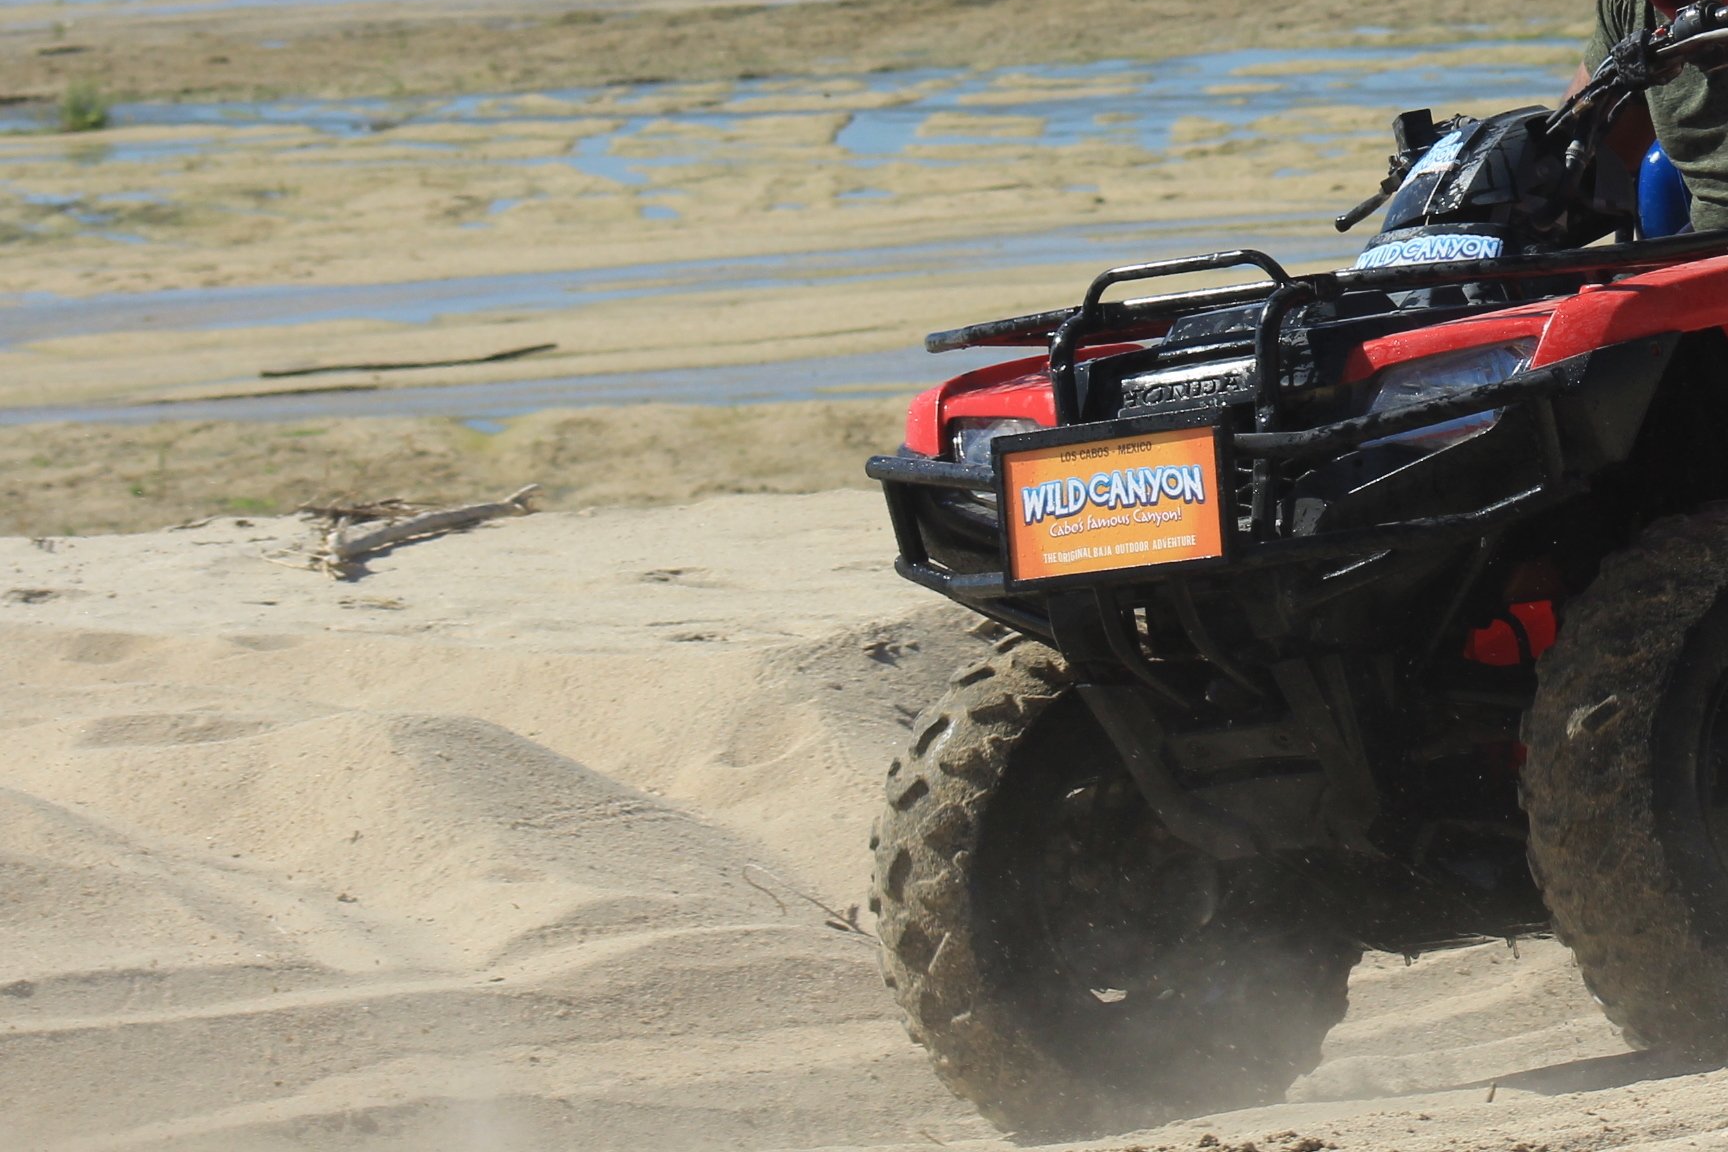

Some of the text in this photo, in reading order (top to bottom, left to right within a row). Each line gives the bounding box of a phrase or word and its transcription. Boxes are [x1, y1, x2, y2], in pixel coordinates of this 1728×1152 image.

[1355, 235, 1503, 269] WILD CANYON
[1124, 374, 1250, 409] HONDA
[1060, 451, 1077, 463] LOS
[1079, 444, 1110, 461] CABOS
[1118, 441, 1152, 456] MEXICO
[1021, 465, 1205, 525] WILD CANYON
[1049, 518, 1084, 538] Cabo's
[1133, 506, 1183, 528] Canyon!
[1043, 535, 1197, 564] THE ORIGINAL BAJA OUTDOOR ADVENTURE
